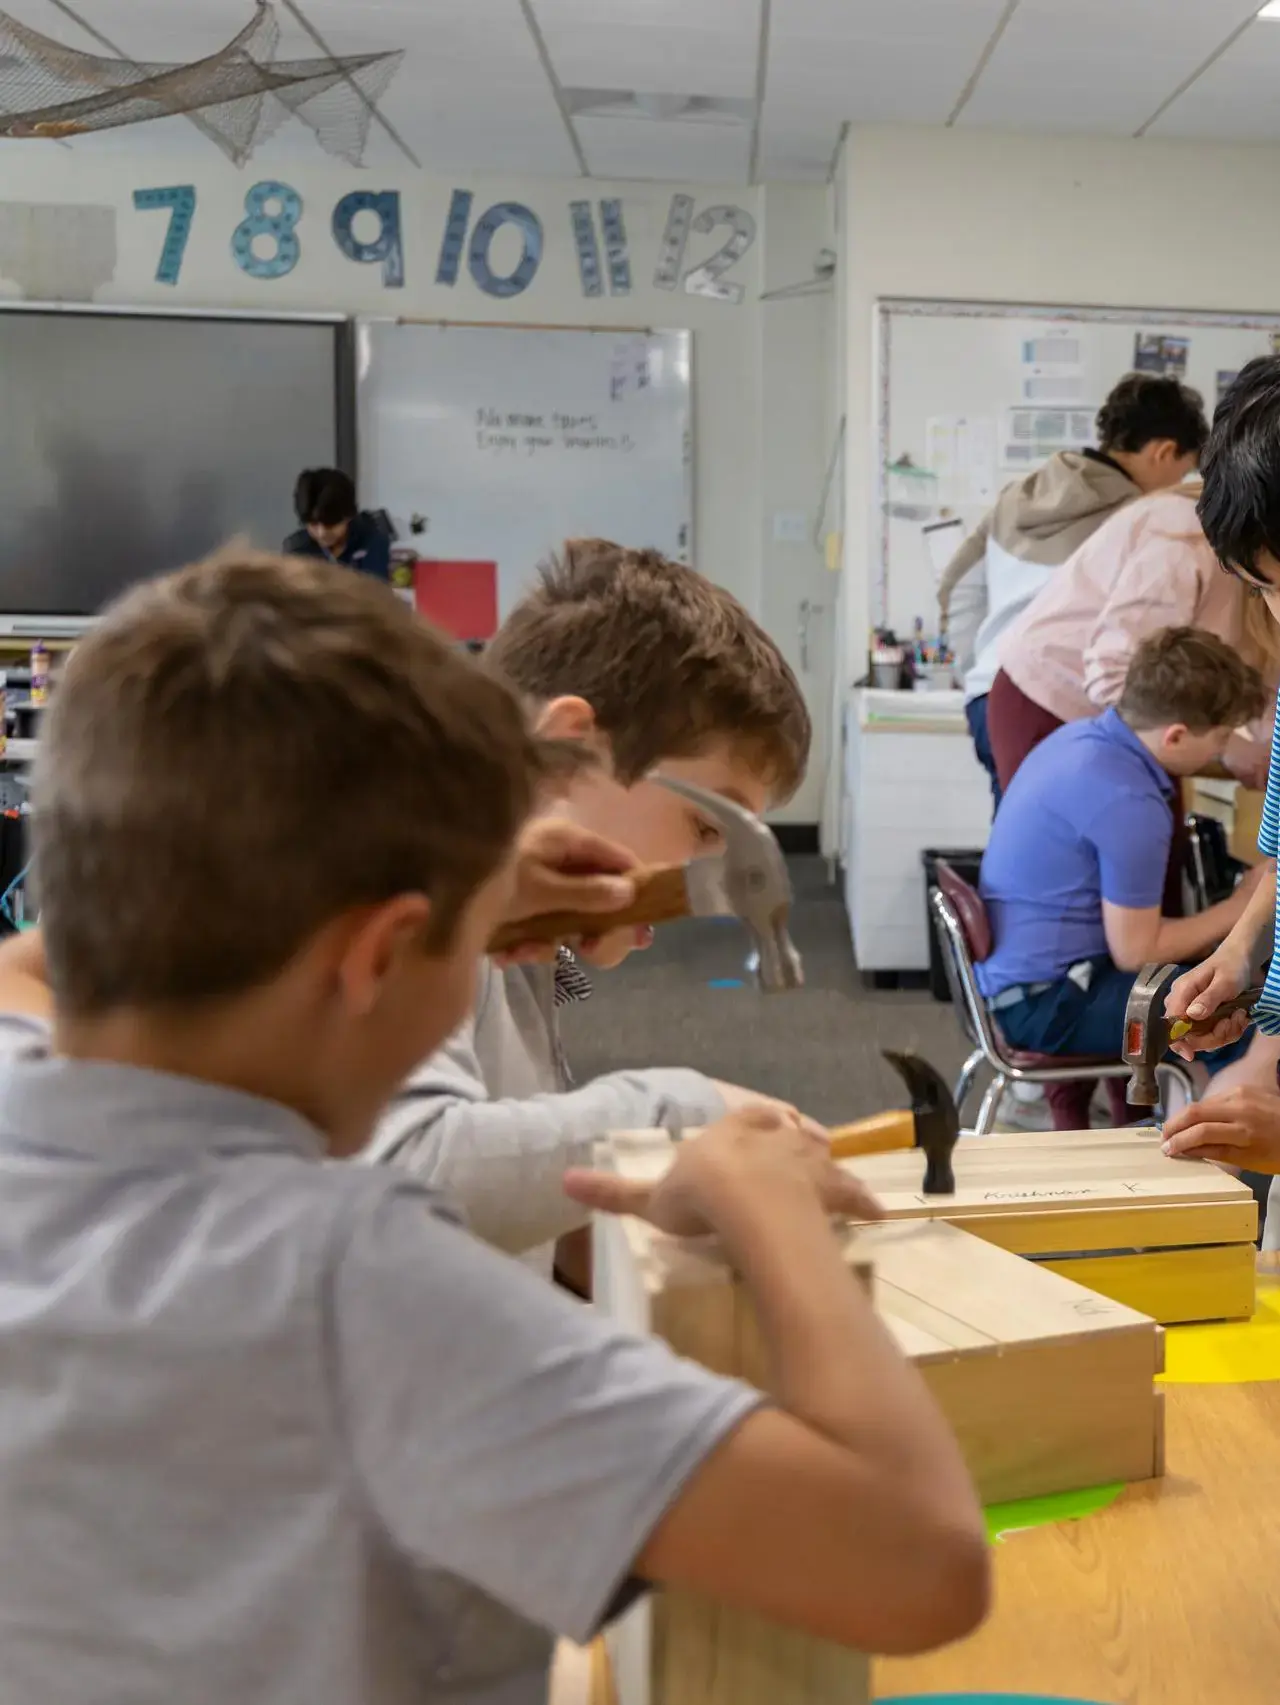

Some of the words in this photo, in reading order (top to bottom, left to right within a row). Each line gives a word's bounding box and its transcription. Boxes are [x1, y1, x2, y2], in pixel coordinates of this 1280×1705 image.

[133, 184, 196, 287] 7
[231, 180, 304, 280] 8
[331, 189, 406, 289] 9
[434, 188, 545, 299] 10
[568, 198, 633, 299] 11
[653, 193, 758, 304] 12
